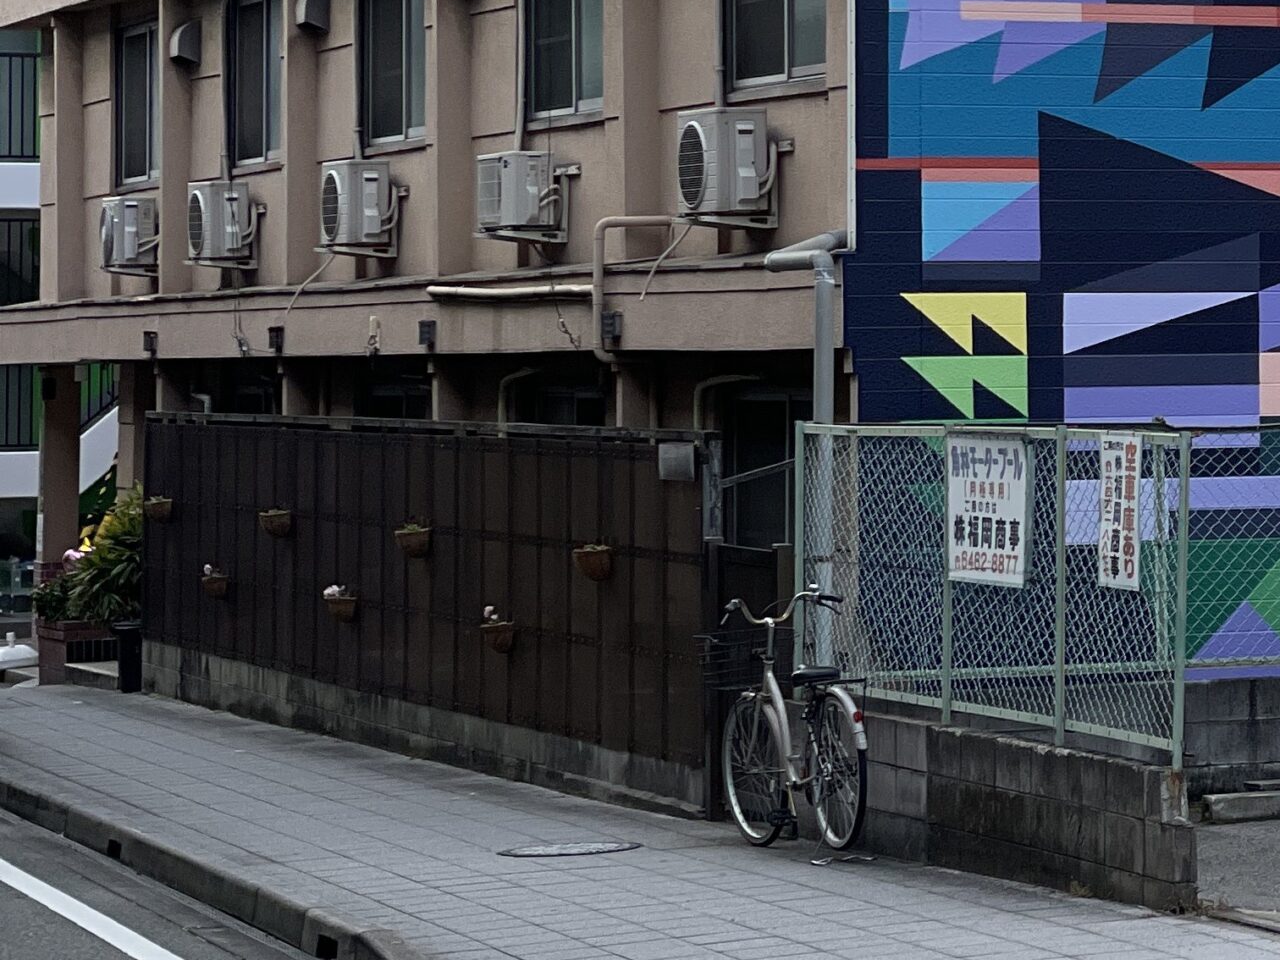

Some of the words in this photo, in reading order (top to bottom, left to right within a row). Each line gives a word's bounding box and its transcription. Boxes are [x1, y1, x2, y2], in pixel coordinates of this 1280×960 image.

[1122, 440, 1137, 579] 空車庫あり
